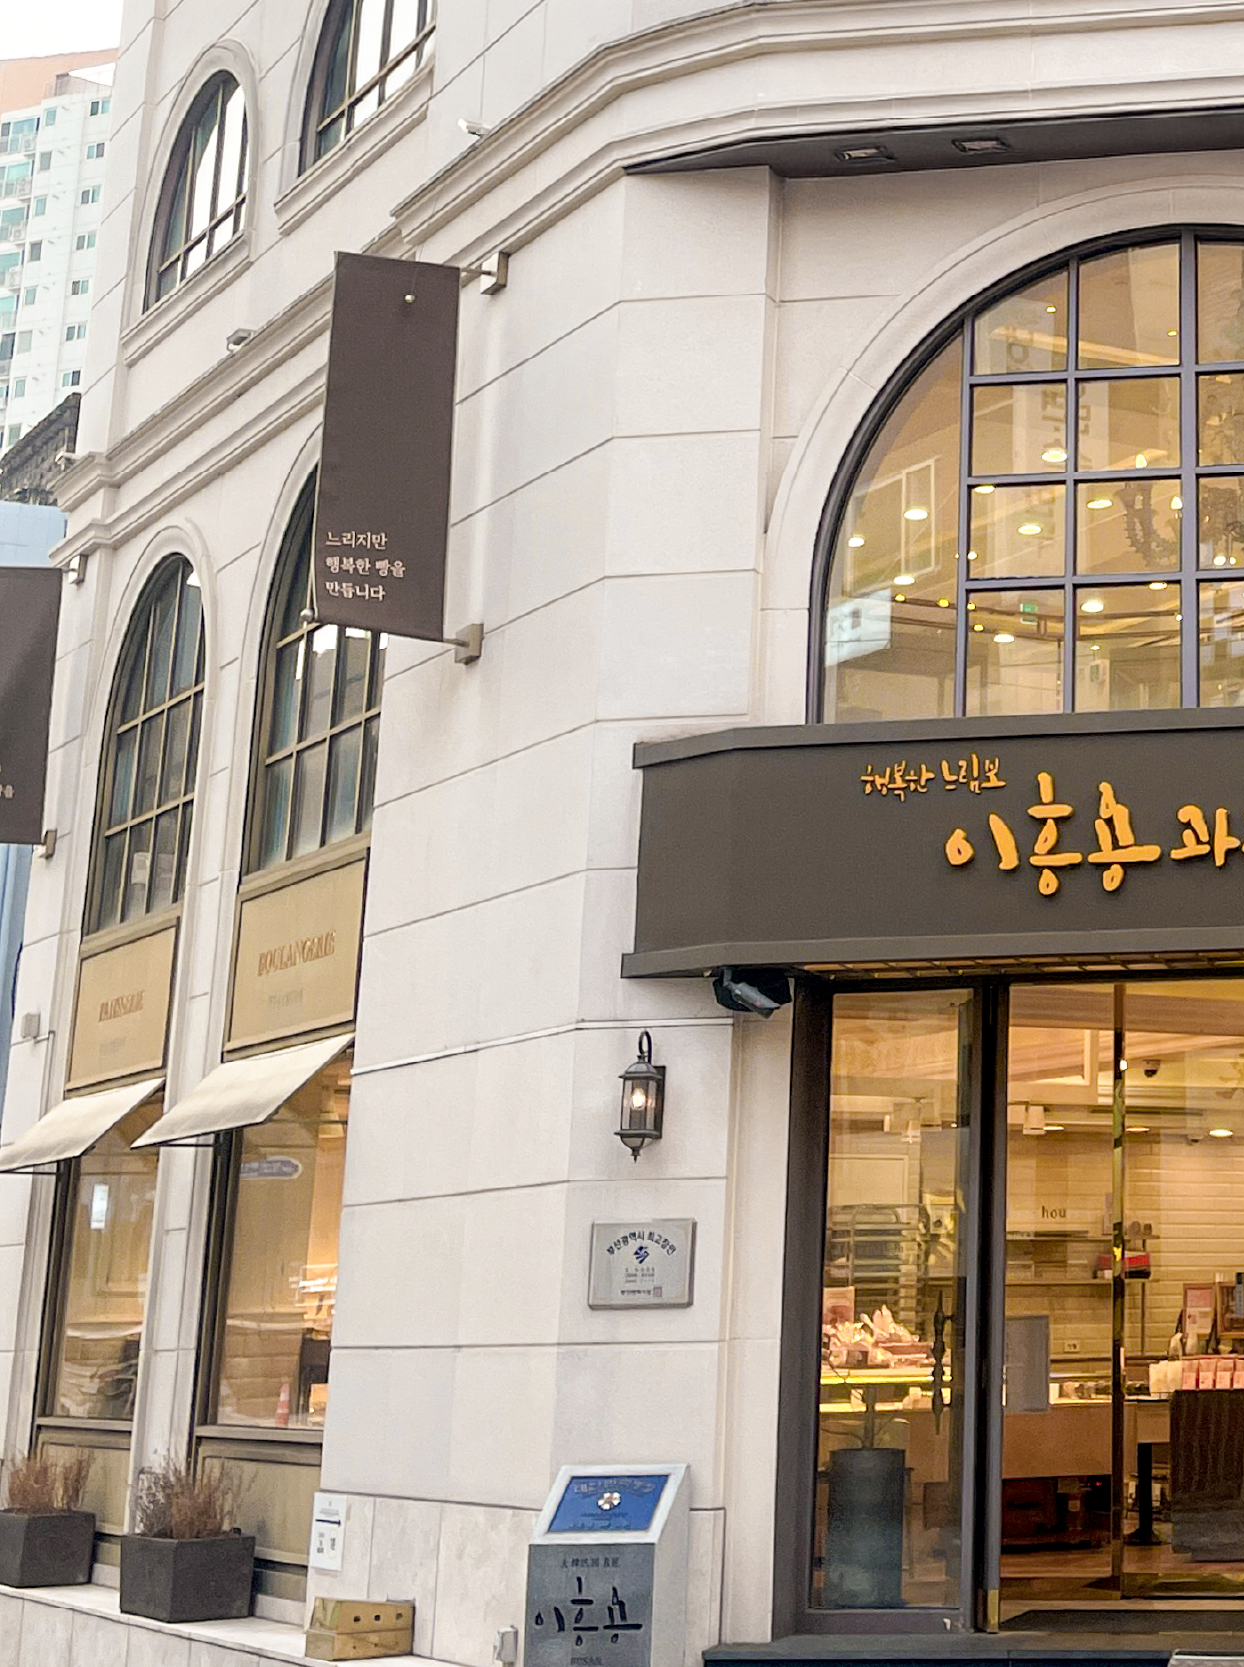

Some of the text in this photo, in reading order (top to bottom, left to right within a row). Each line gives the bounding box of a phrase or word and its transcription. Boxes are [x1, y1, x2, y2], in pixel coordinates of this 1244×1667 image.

[325, 530, 388, 550] 느리지만
[325, 556, 406, 577] 행복한 빵을
[325, 581, 386, 601] 만듭니다
[861, 753, 1006, 801] 행복한 느림보
